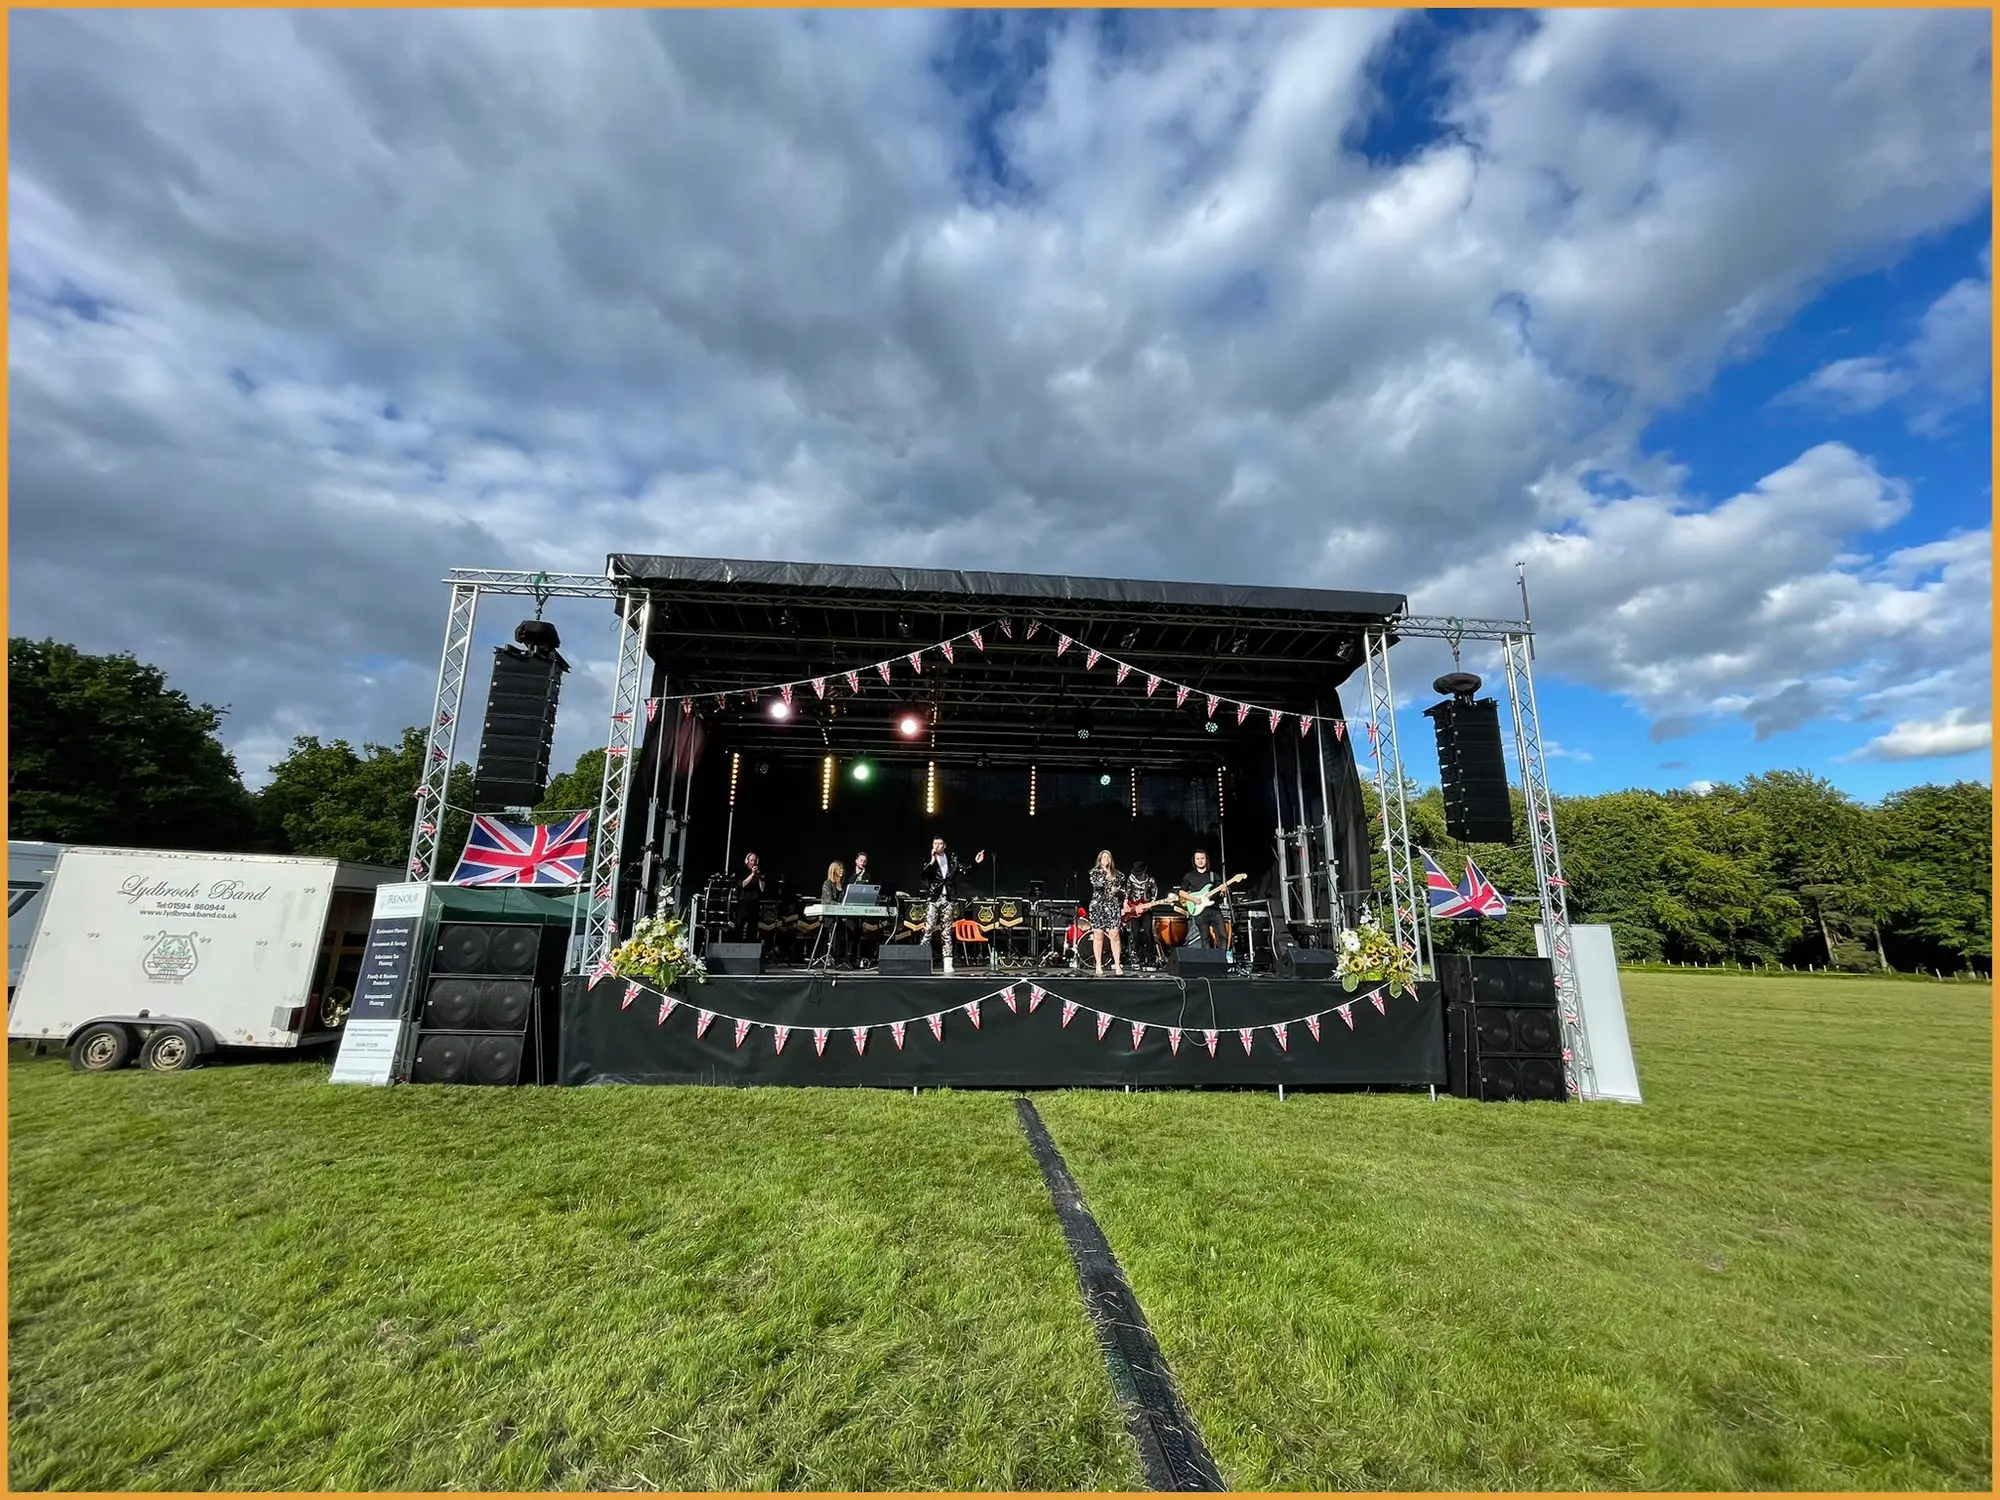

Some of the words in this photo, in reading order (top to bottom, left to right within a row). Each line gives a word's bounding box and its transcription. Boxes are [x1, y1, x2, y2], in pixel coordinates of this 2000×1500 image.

[116, 874, 201, 904] Lydbrook
[208, 879, 272, 901] Band
[193, 903, 226, 911] 860944
[139, 909, 238, 920] www.lydbrookband.co.uk
